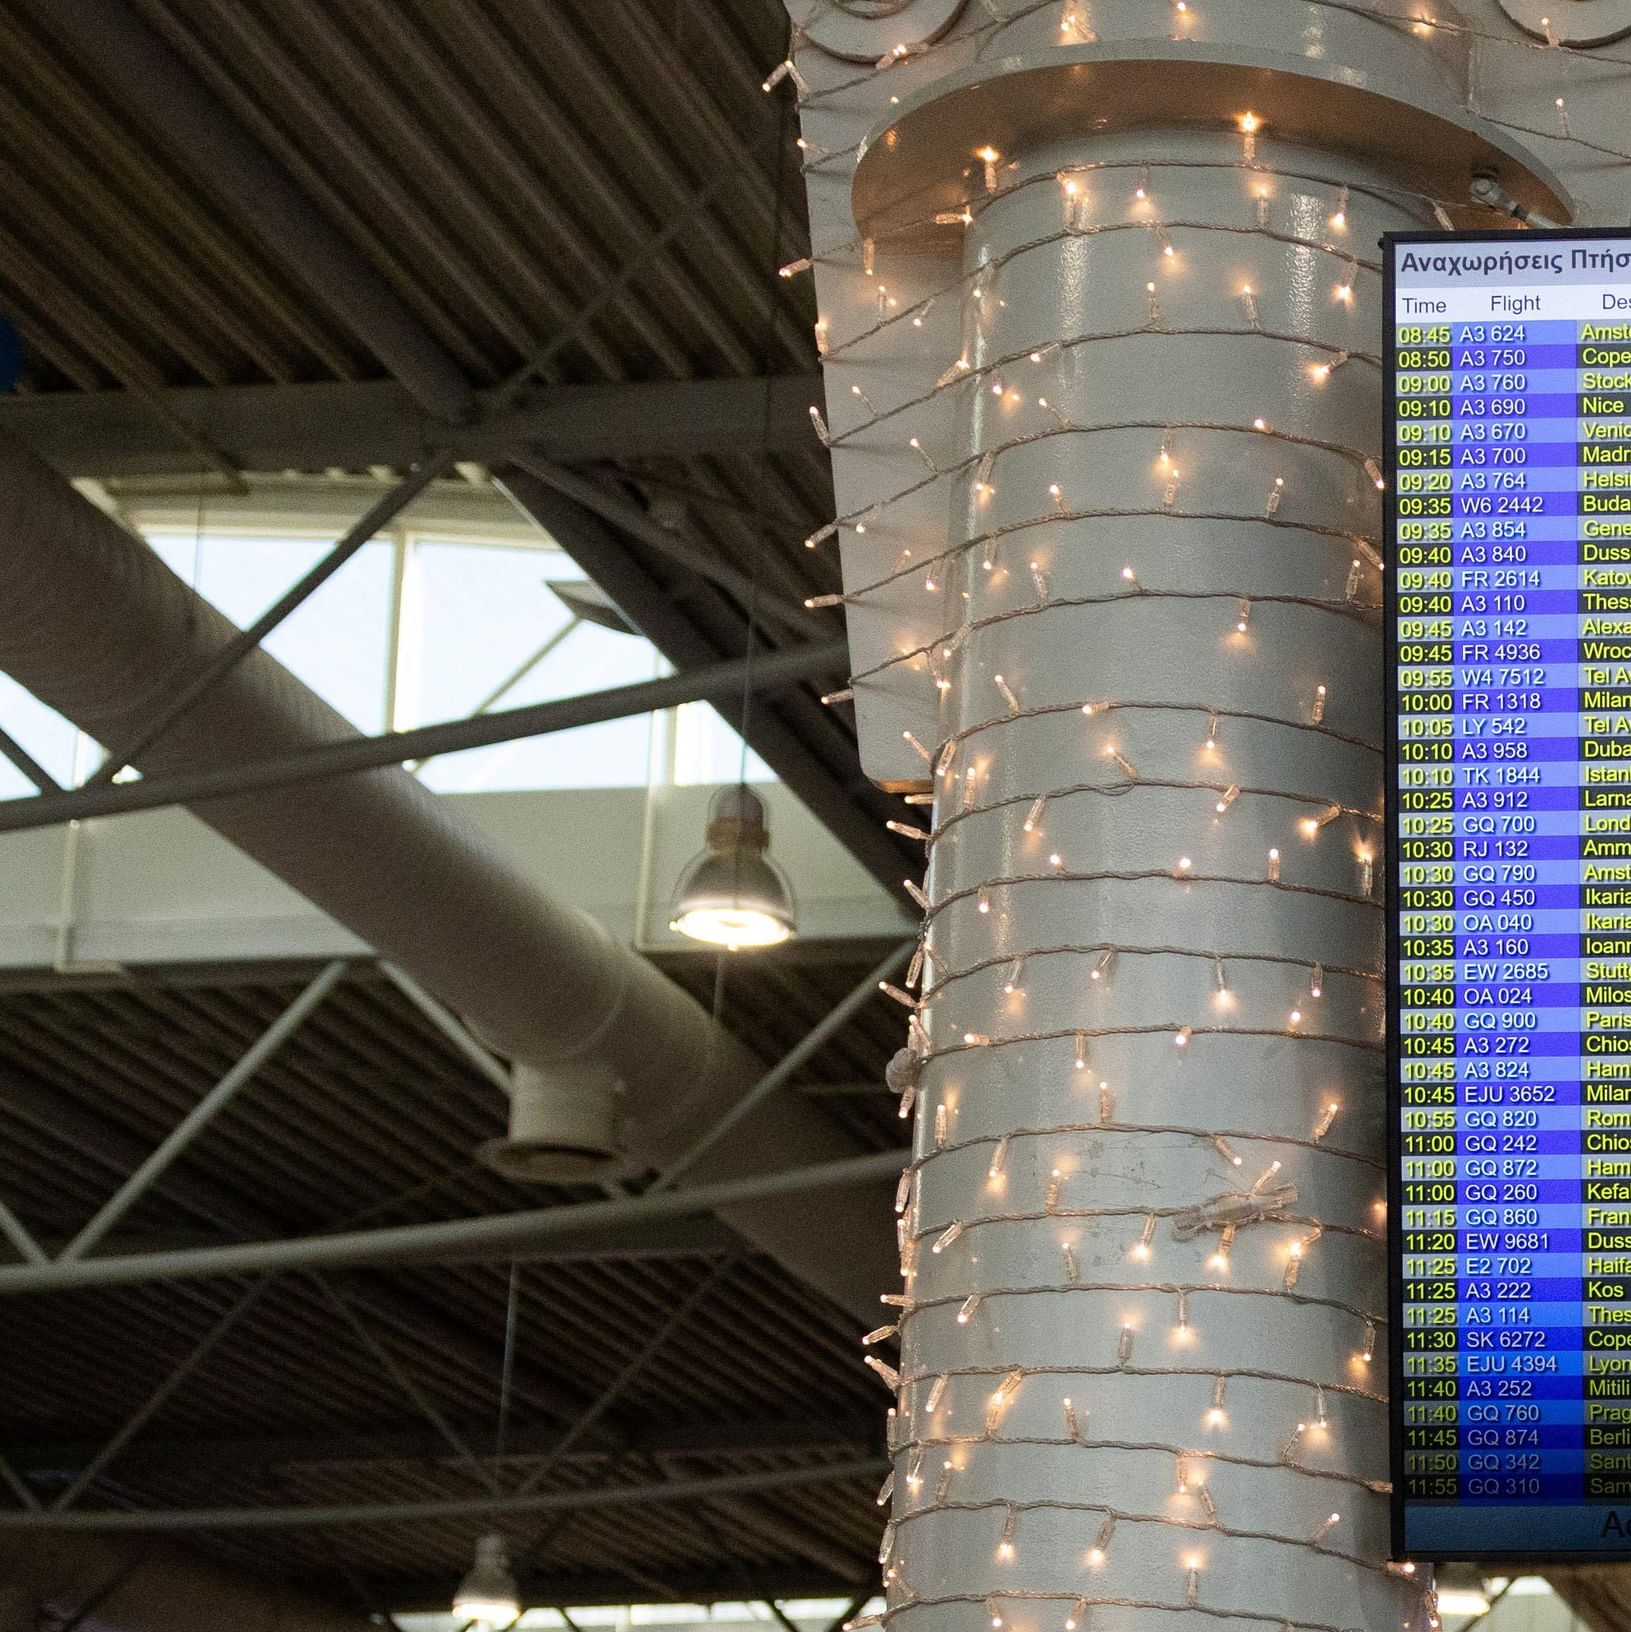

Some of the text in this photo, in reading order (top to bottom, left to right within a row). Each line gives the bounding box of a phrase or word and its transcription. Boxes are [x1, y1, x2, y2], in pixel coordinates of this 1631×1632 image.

[1401, 250, 1563, 276] Αναχωρήσεις
[1402, 295, 1446, 314] Time
[1489, 292, 1541, 315] Flight
[1398, 324, 1451, 344] 08:45
[1461, 325, 1488, 342] A3
[1493, 324, 1526, 342] 624
[1406, 1257, 1455, 1276] 11:25
[1467, 1257, 1493, 1275] E2
[1499, 1257, 1532, 1275] 702
